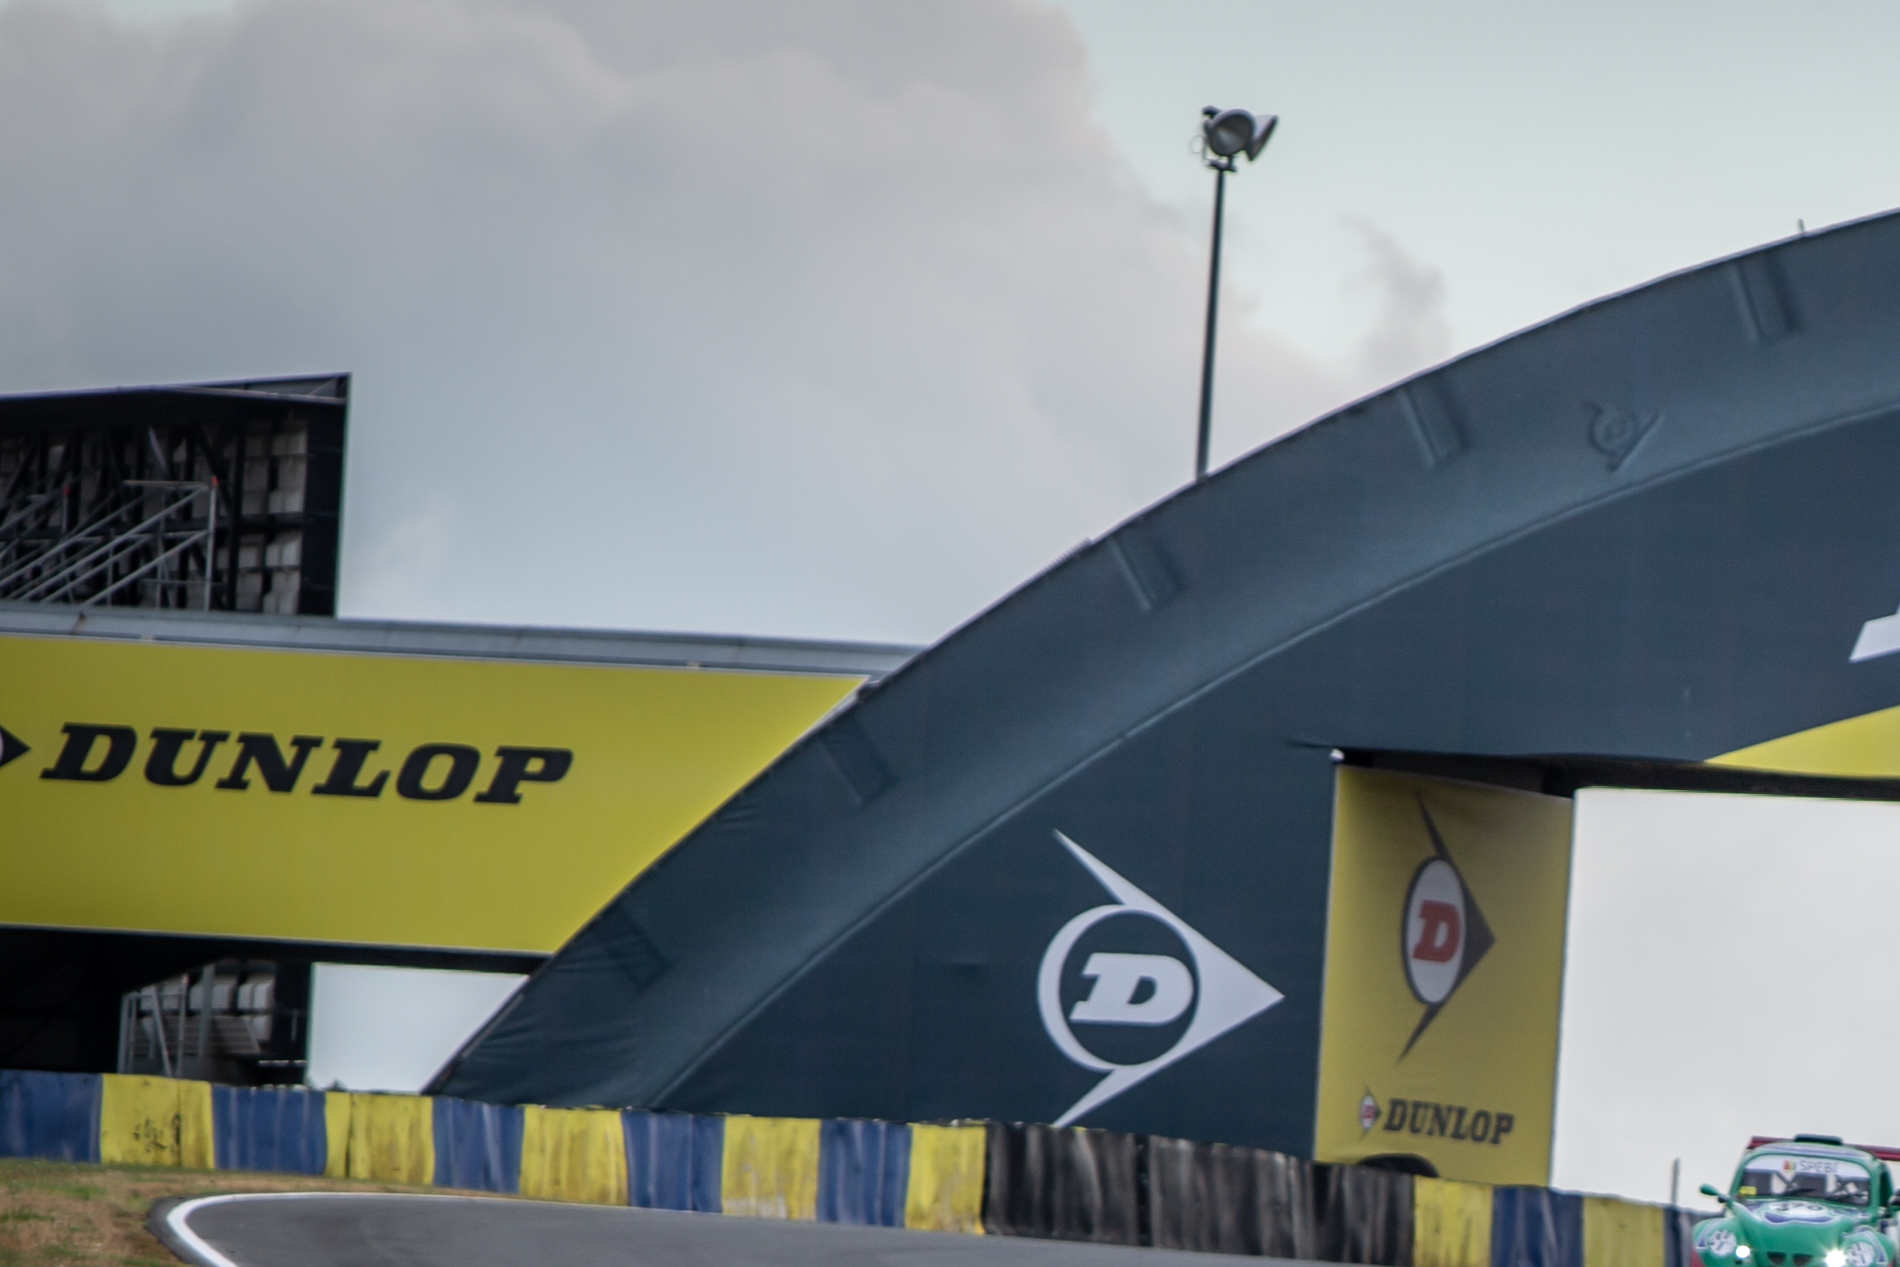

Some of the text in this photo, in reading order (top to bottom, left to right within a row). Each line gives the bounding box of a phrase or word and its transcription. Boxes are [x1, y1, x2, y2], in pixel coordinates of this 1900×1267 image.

[40, 721, 574, 805] DUNLOP
[1412, 899, 1461, 963] D
[1068, 952, 1195, 1025] D
[1383, 1098, 1515, 1146] DUNLOP
